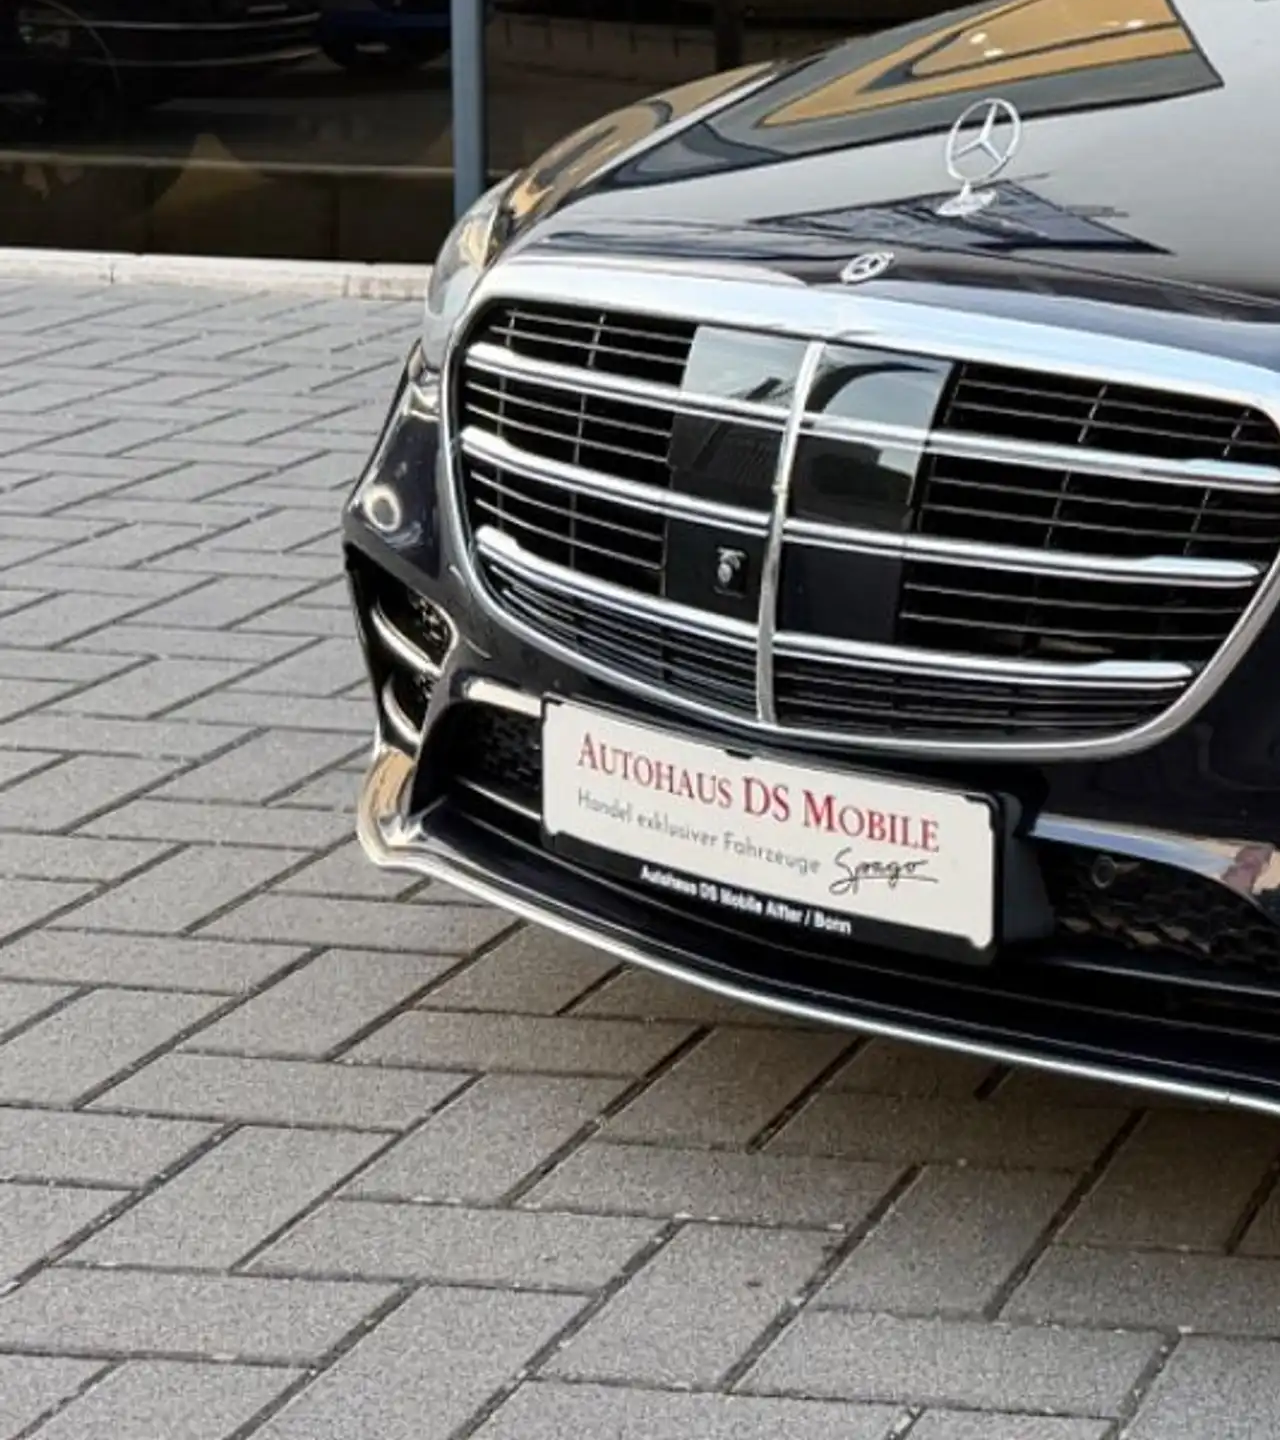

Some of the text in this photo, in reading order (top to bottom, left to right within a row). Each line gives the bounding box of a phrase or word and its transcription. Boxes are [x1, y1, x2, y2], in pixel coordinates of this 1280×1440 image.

[577, 732, 940, 853] AUTOHAUS DS MOBILE
[577, 786, 821, 876] Handel exklusiver Fahrzeuge
[639, 863, 698, 896] Autohaus
[700, 881, 718, 902] DS
[719, 886, 763, 916] Mobile
[813, 910, 852, 936] Bonn
